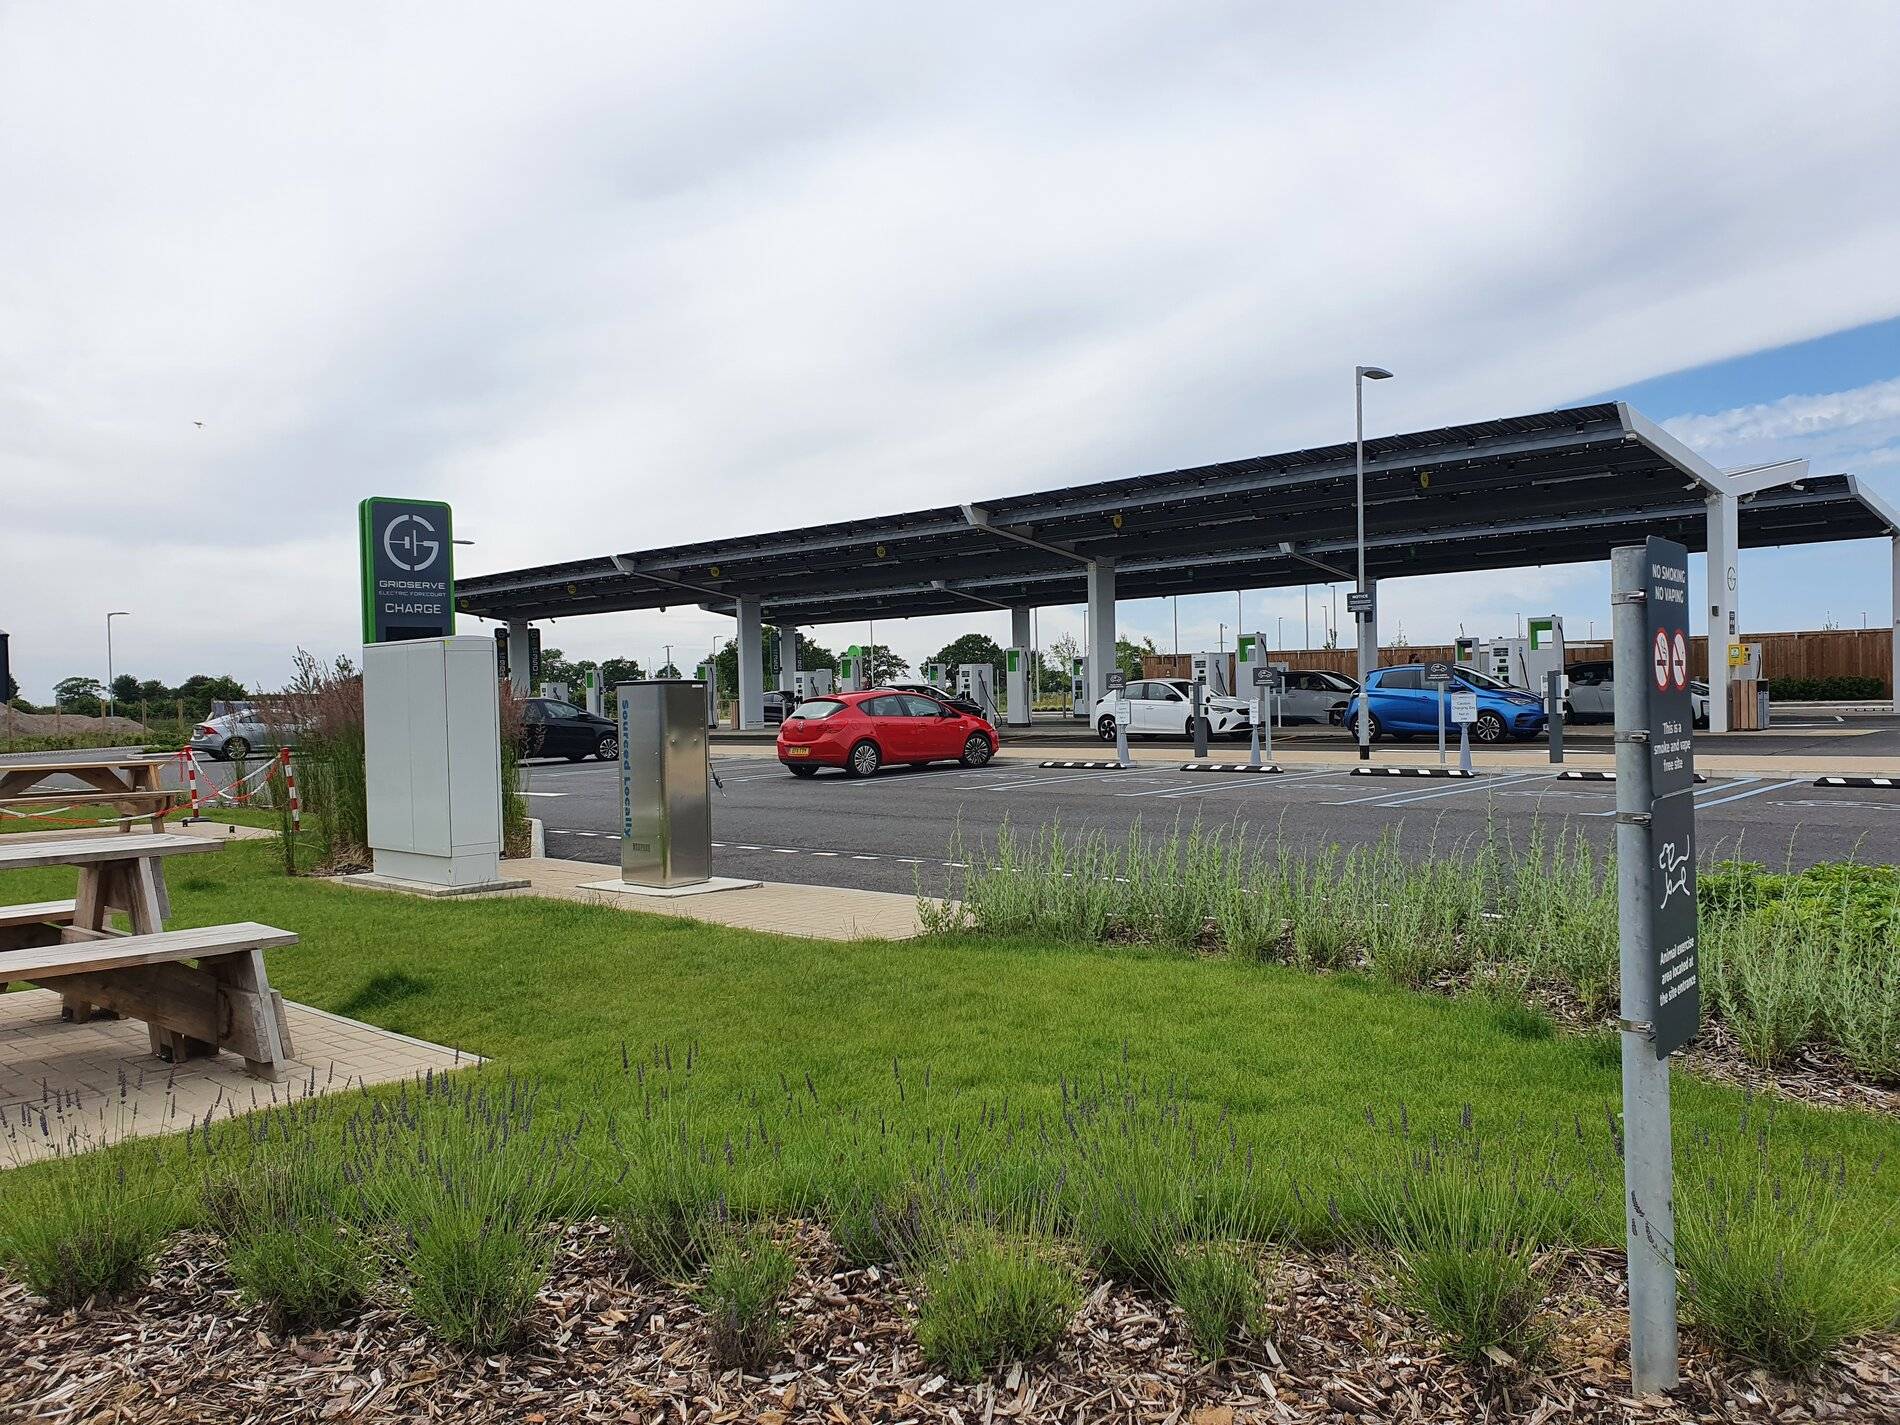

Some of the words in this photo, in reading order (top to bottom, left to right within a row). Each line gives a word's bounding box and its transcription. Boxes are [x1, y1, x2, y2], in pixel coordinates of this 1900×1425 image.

[1652, 563, 1662, 579] NO
[1661, 565, 1686, 584] SMOKING
[379, 580, 446, 590] GRIDSERVE
[1655, 585, 1664, 601] NO
[1664, 587, 1684, 604] VAPING
[385, 603, 442, 614] CHARGE
[622, 699, 631, 771] Sourced
[1662, 721, 1673, 734] This
[1673, 720, 1678, 733] is
[1678, 723, 1682, 733] a
[1653, 740, 1670, 755] smoke
[1670, 739, 1680, 752] and
[1680, 740, 1691, 753] vape
[1663, 759, 1674, 772] free
[1674, 756, 1683, 770] site
[624, 776, 633, 839] Locally
[1660, 943, 1677, 966] Animal
[1677, 936, 1695, 956] exercise
[1662, 970, 1673, 985] area
[1672, 956, 1689, 979] located
[1688, 955, 1694, 968] at
[1660, 992, 1669, 1007] the
[1668, 985, 1677, 1002] site
[1677, 974, 1697, 996] entrance
